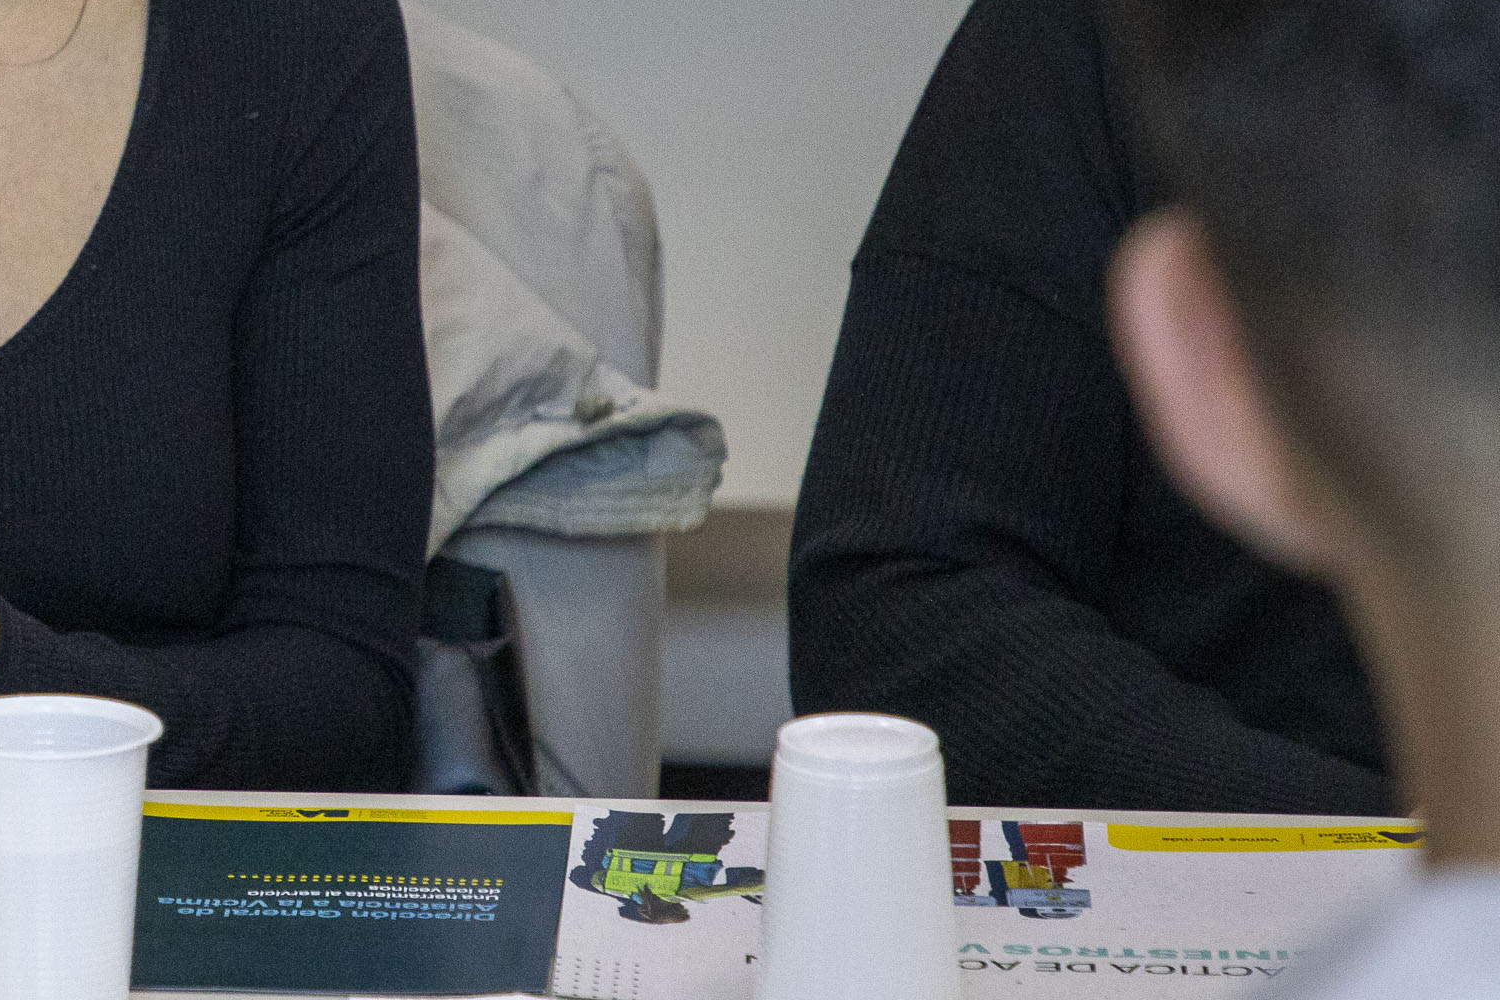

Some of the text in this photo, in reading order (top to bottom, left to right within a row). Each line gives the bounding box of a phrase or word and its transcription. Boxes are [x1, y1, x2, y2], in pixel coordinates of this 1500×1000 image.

[247, 890, 321, 898] servicio
[367, 885, 501, 895] de los vecinos
[344, 891, 458, 901] herramienta
[278, 899, 302, 909] la
[313, 899, 330, 908] a
[339, 899, 498, 912] Asistencia
[177, 907, 496, 922] Dirección General de
[958, 943, 1299, 961] INIESTROS V
[958, 959, 1021, 971] AC
[1034, 961, 1097, 974] DE
